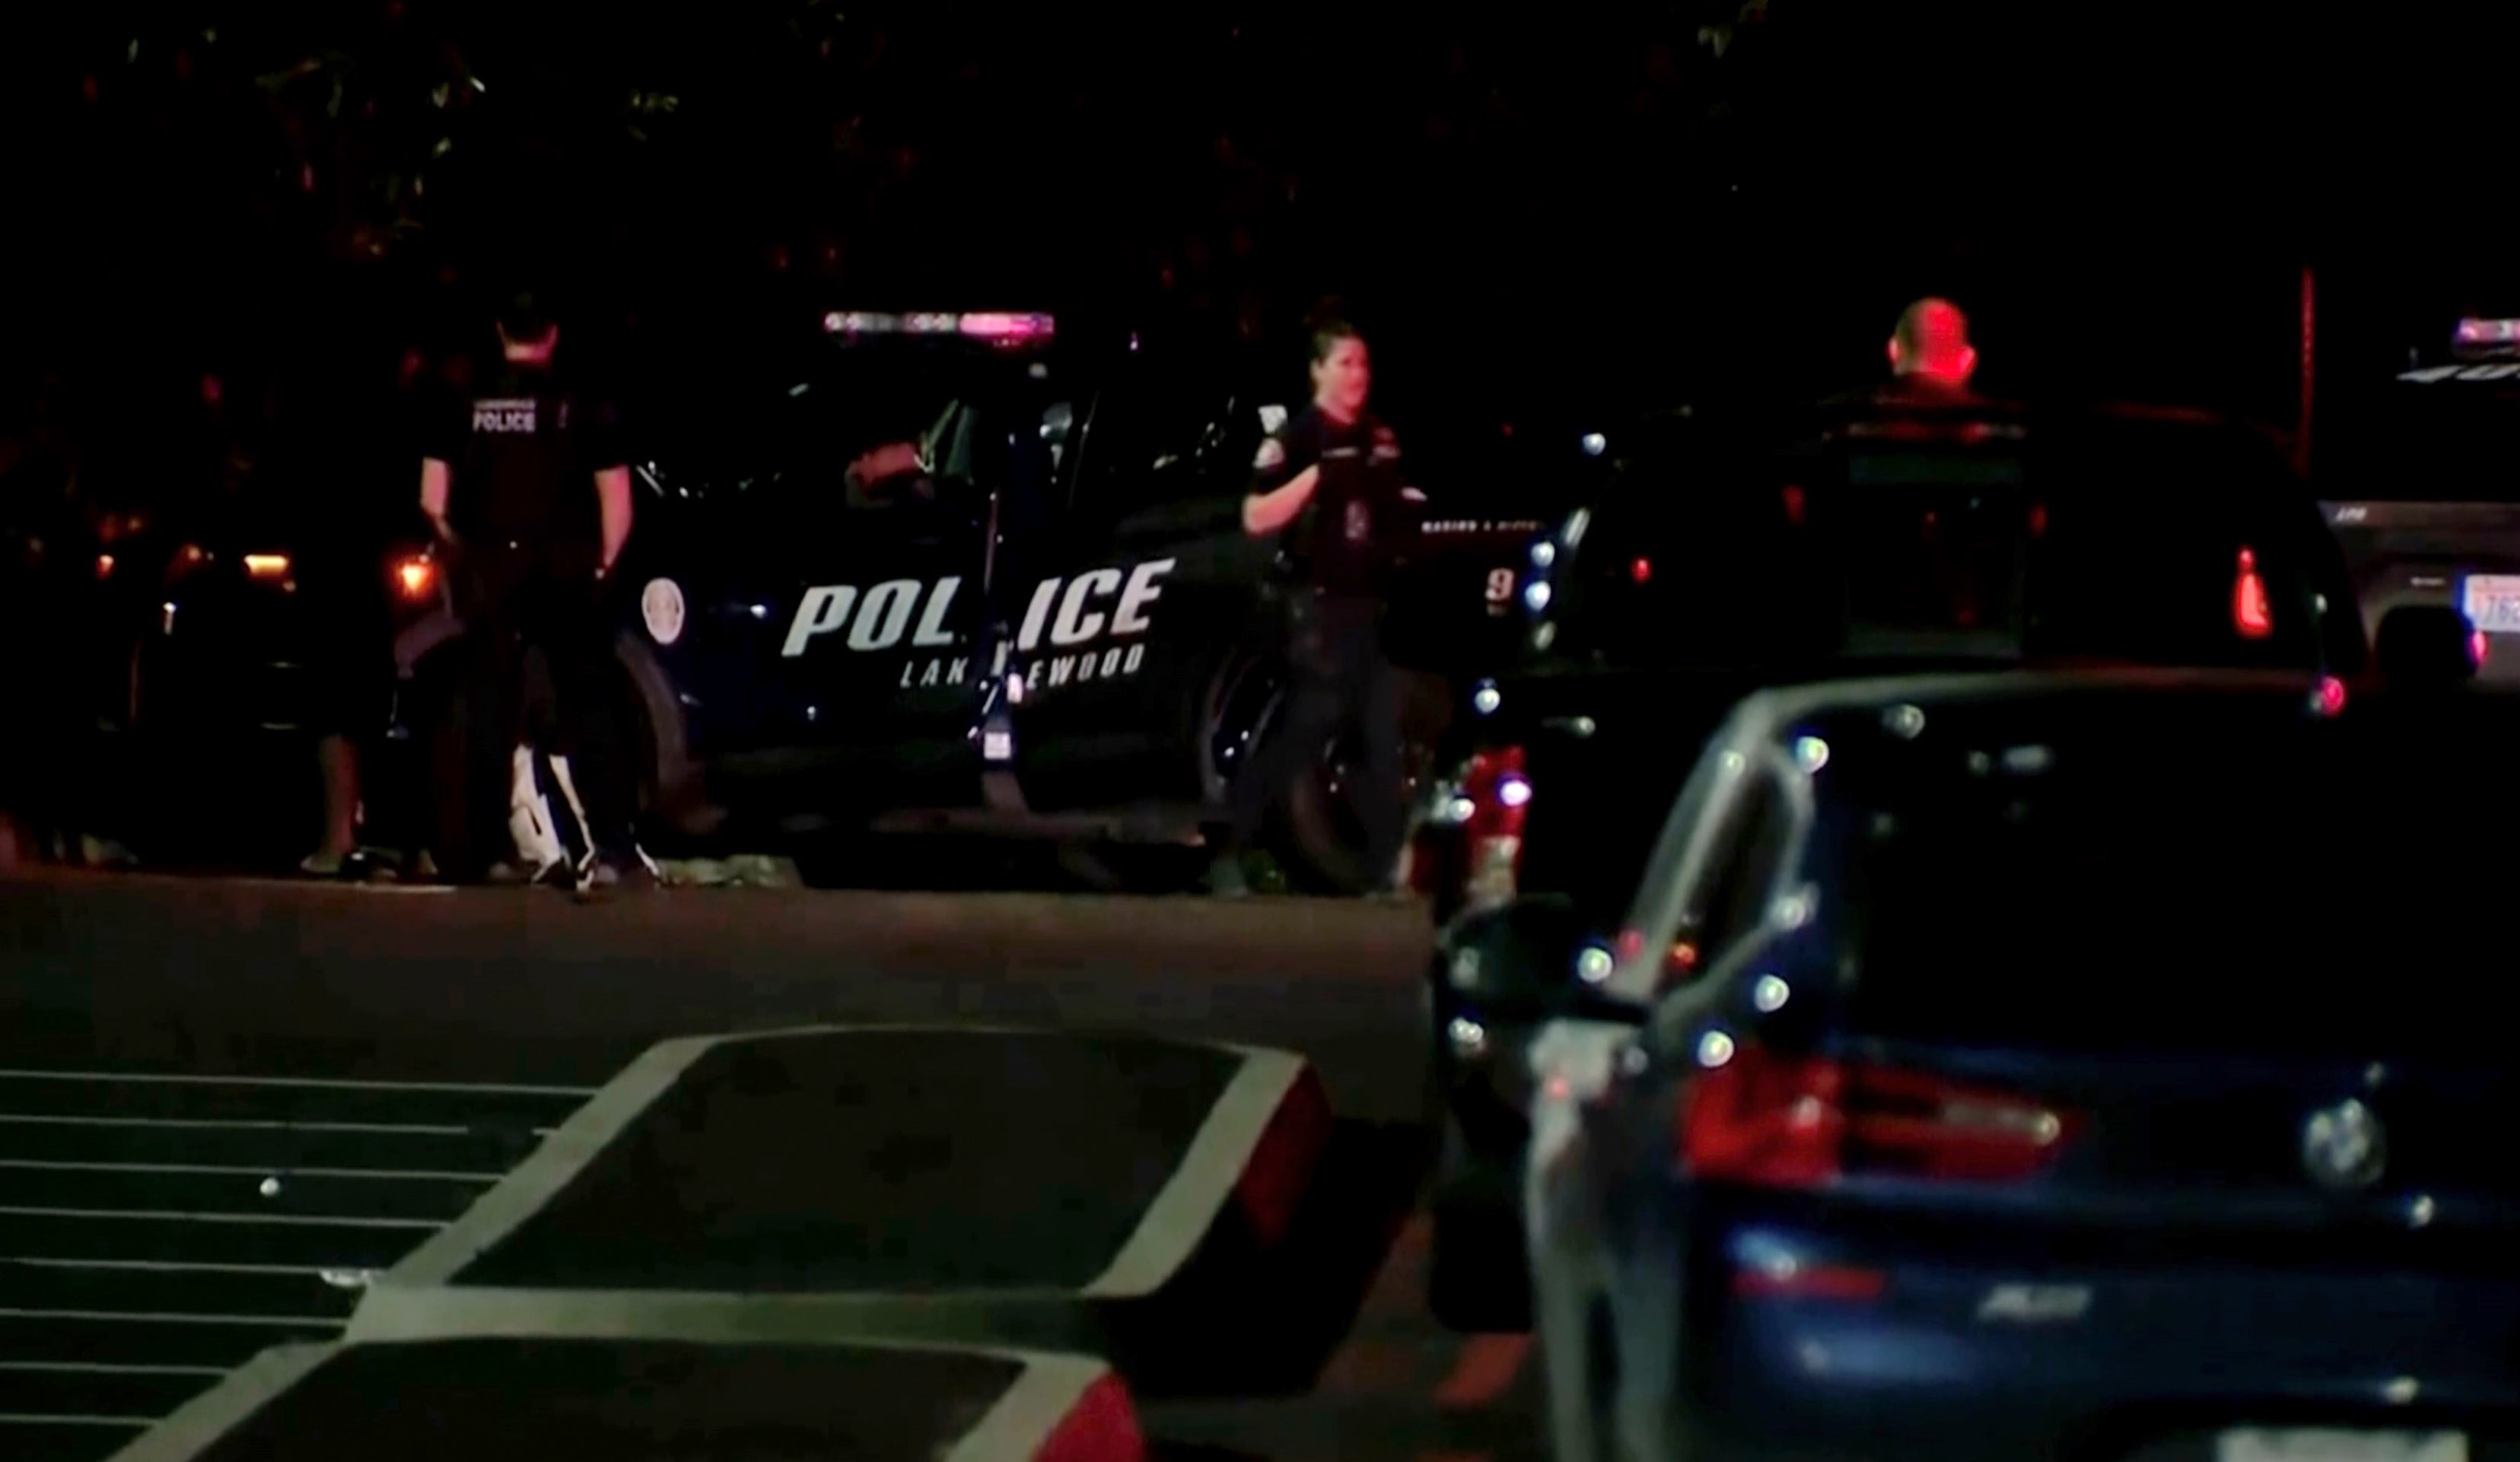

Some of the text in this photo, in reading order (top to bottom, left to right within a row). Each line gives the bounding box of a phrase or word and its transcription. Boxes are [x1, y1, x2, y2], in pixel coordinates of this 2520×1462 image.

[472, 410, 536, 433] POLICE
[781, 558, 1176, 656] POLICE
[900, 644, 1145, 688] LAKEWOOD
